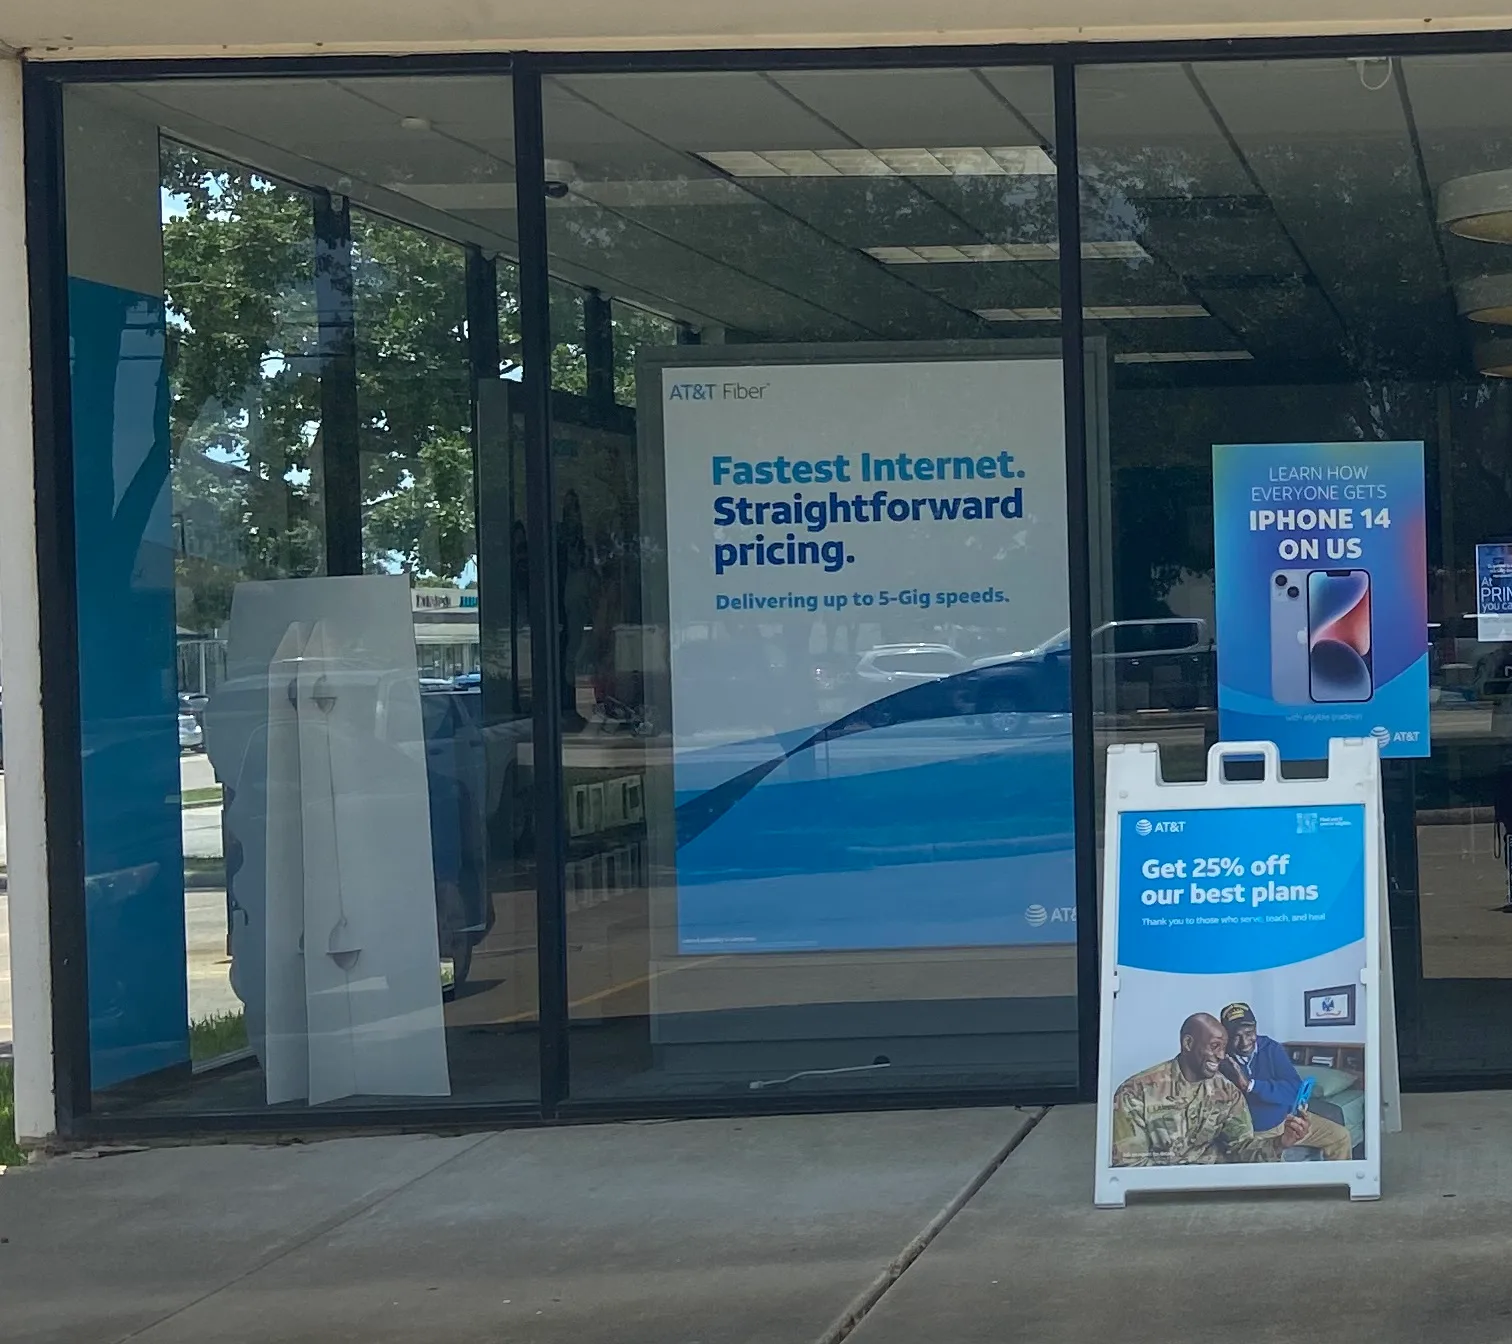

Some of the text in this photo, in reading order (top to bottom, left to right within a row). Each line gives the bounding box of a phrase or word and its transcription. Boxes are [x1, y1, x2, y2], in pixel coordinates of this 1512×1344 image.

[669, 383, 717, 401] AT&T
[712, 451, 1026, 485] Fastest Internet.
[1269, 466, 1369, 482] LEARN HOW
[1251, 484, 1387, 502] EVERYONE GETS
[713, 487, 1023, 533] Straightforward
[1249, 508, 1391, 531] IPHONE 14
[715, 533, 855, 575] pricing.
[1279, 537, 1362, 560] ON US
[1481, 576, 1493, 587] At
[715, 587, 1010, 612] Delivering up to 5-Gig speeds.
[1481, 603, 1500, 614] you
[1393, 731, 1420, 742] AT&T
[1154, 821, 1186, 833] AT&T
[1142, 854, 1291, 879] Get 25% off
[1141, 880, 1319, 907] our best plans
[1142, 917, 1167, 927] Thank
[1168, 917, 1185, 928] you
[1186, 916, 1195, 926] to
[1196, 915, 1219, 925] those
[1220, 915, 1239, 924] who
[1291, 913, 1307, 922] and
[1308, 912, 1326, 922] heal
